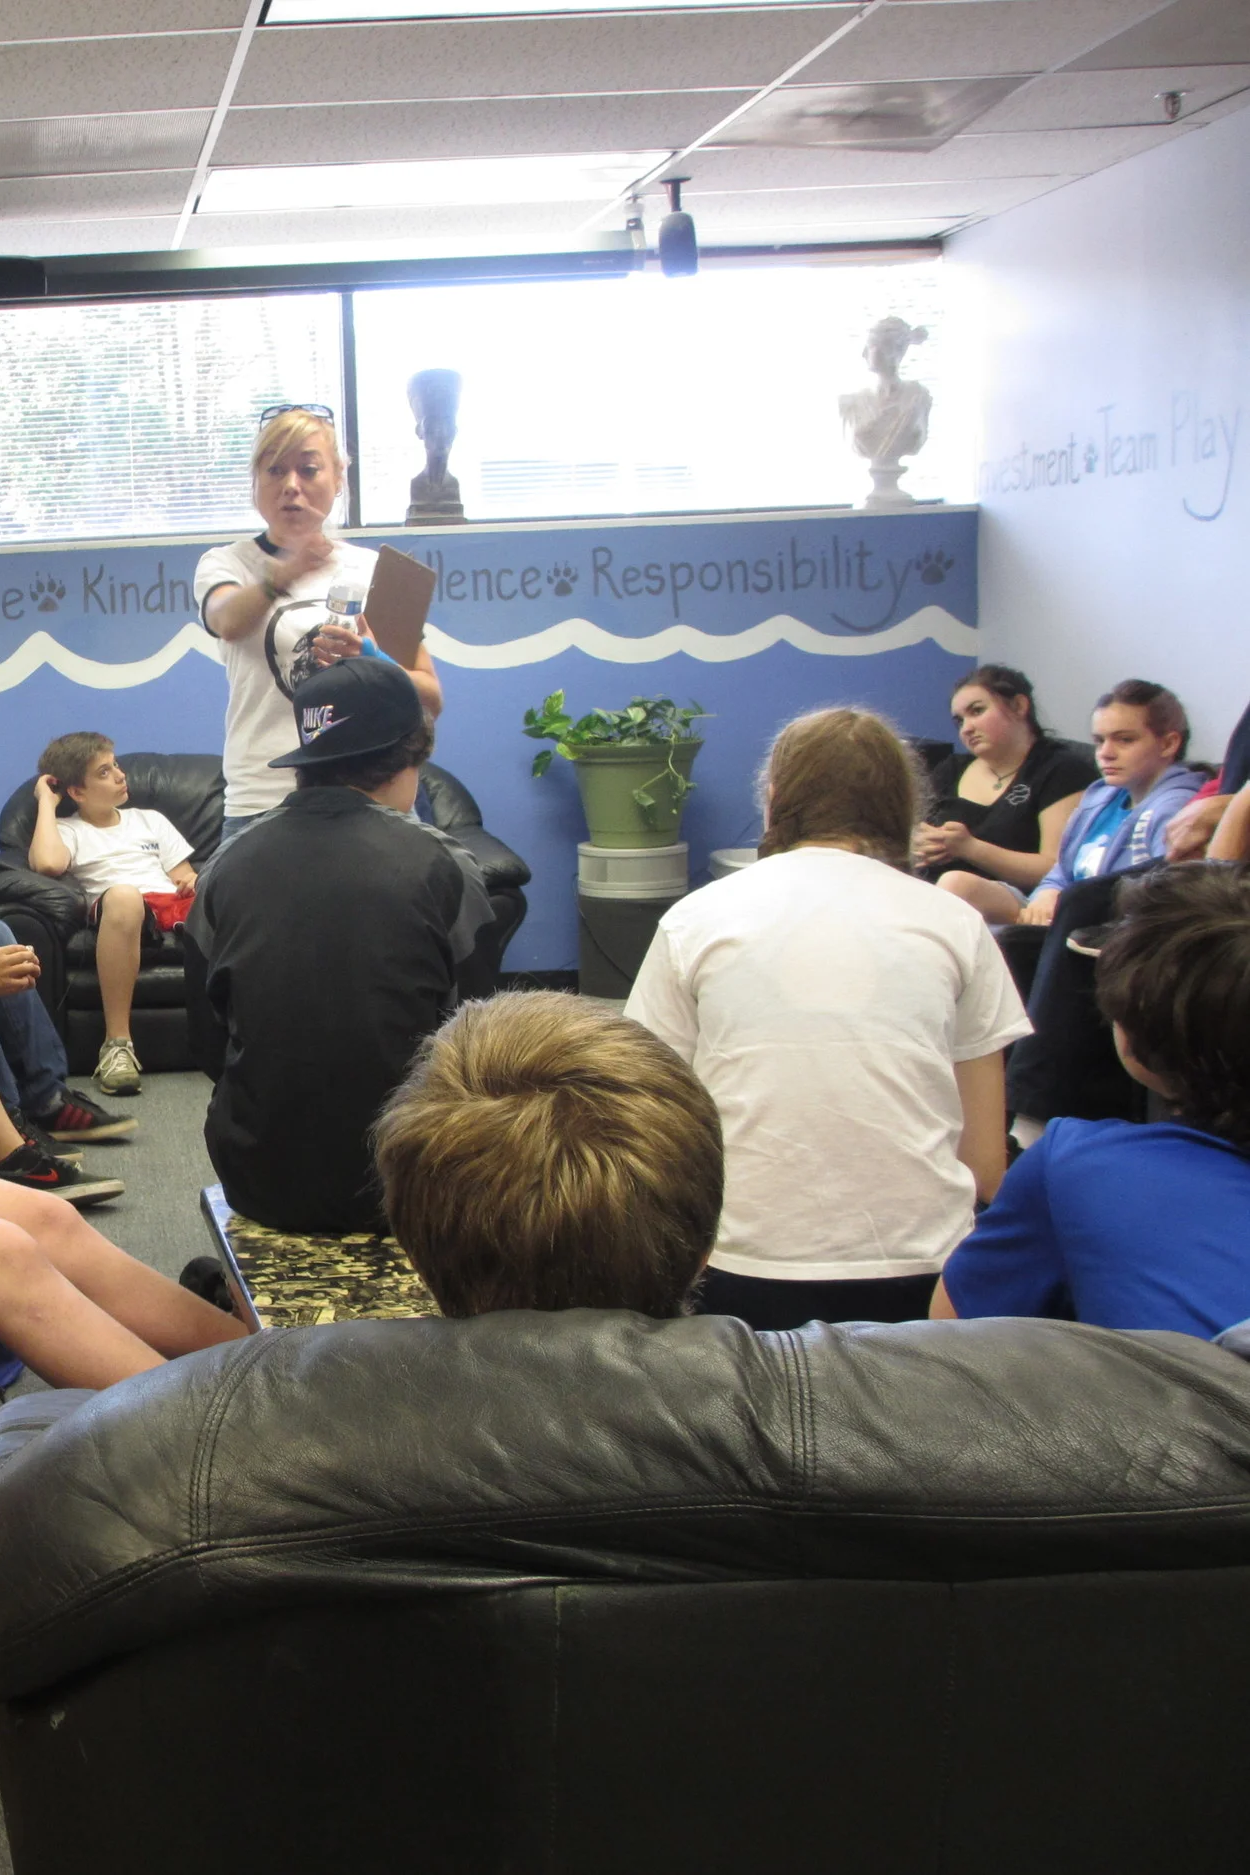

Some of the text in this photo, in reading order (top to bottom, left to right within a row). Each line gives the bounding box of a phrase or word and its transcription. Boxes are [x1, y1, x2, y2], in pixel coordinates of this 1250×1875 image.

[1097, 402, 1158, 478] Team
[1170, 388, 1241, 522] Play
[591, 535, 914, 633] Responsibility
[302, 705, 333, 729] NIKE
